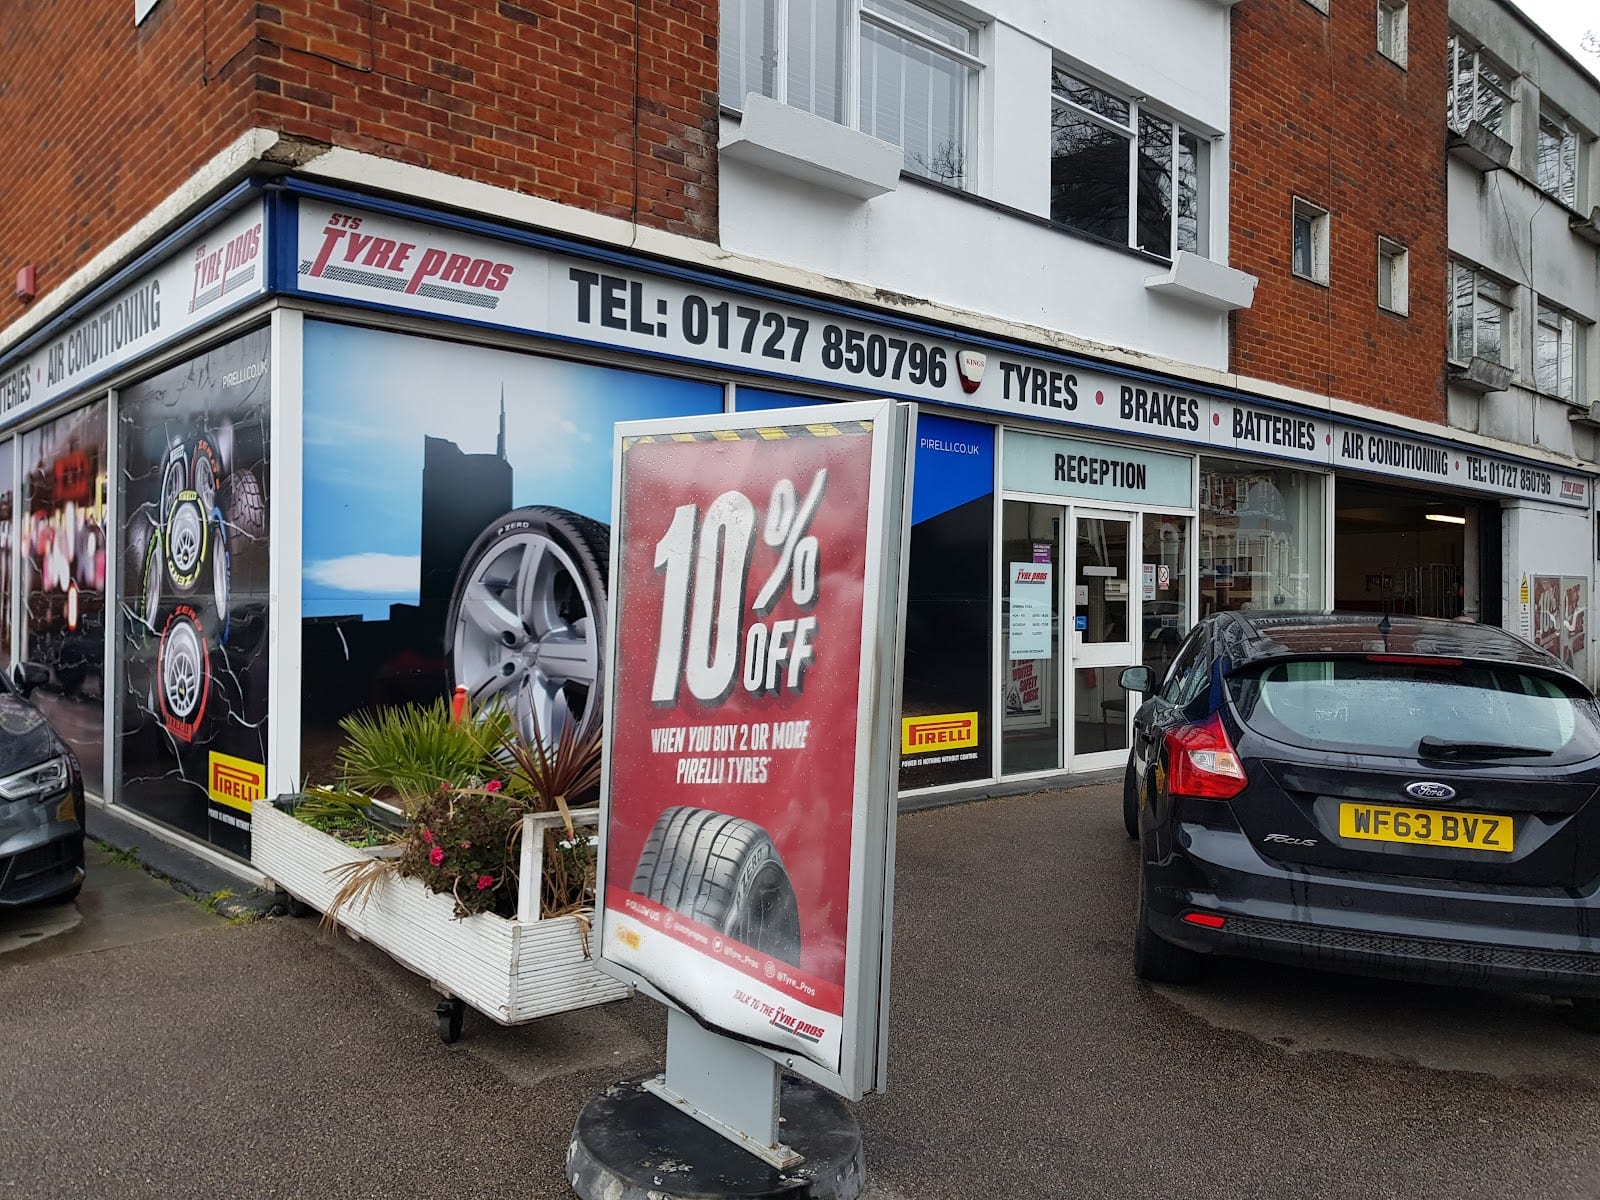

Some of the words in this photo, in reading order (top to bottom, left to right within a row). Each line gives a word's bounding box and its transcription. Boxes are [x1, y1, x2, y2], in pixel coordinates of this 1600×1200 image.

[328, 213, 363, 230] STS
[192, 247, 224, 312] TYRE
[221, 223, 262, 296] PROS
[308, 226, 417, 277] TYRE
[404, 247, 514, 294] PROS
[569, 267, 667, 338] TEL:
[682, 294, 809, 363] 01727
[821, 324, 947, 388] 850796
[0, 363, 31, 415] TERIES
[47, 345, 65, 387] AIR
[68, 280, 161, 375] CONDITIONING
[965, 357, 985, 368] KINGS
[999, 361, 1078, 411] TYRES
[1119, 385, 1199, 432] BRAKES
[1232, 407, 1316, 450] BATTERIES
[1341, 431, 1364, 461] AIR
[1368, 436, 1448, 475] CONDITIONING
[1467, 455, 1487, 482] TEL:
[1489, 461, 1517, 489] 01727
[1520, 468, 1550, 495] 850796
[920, 438, 979, 455] PIRELLI.CO.UK
[1054, 453, 1147, 490] RECEPTION
[504, 521, 530, 532] ZERO
[652, 467, 828, 706] 10%
[743, 615, 818, 699] OFF
[651, 727, 686, 753] WHEN
[688, 725, 713, 752] YOU
[713, 724, 738, 752] BUY
[739, 723, 748, 750] 2
[751, 723, 770, 750] OR
[771, 720, 811, 749] MORE
[908, 720, 972, 746] PIRELLI
[213, 762, 259, 802] PIRELLI
[676, 757, 725, 784] PIRELLI
[1418, 783, 1445, 797] Ford
[1354, 808, 1432, 838] WF63
[1442, 816, 1500, 846] BVZ
[625, 898, 649, 917] FOLLOW
[649, 908, 660, 921] US
[777, 971, 816, 996] @Tyre_Pros
[733, 989, 752, 1004] TALK
[751, 998, 759, 1010] TO
[760, 1003, 775, 1018] THE
[771, 1010, 798, 1027] TYRE
[792, 1020, 825, 1038] PROS
